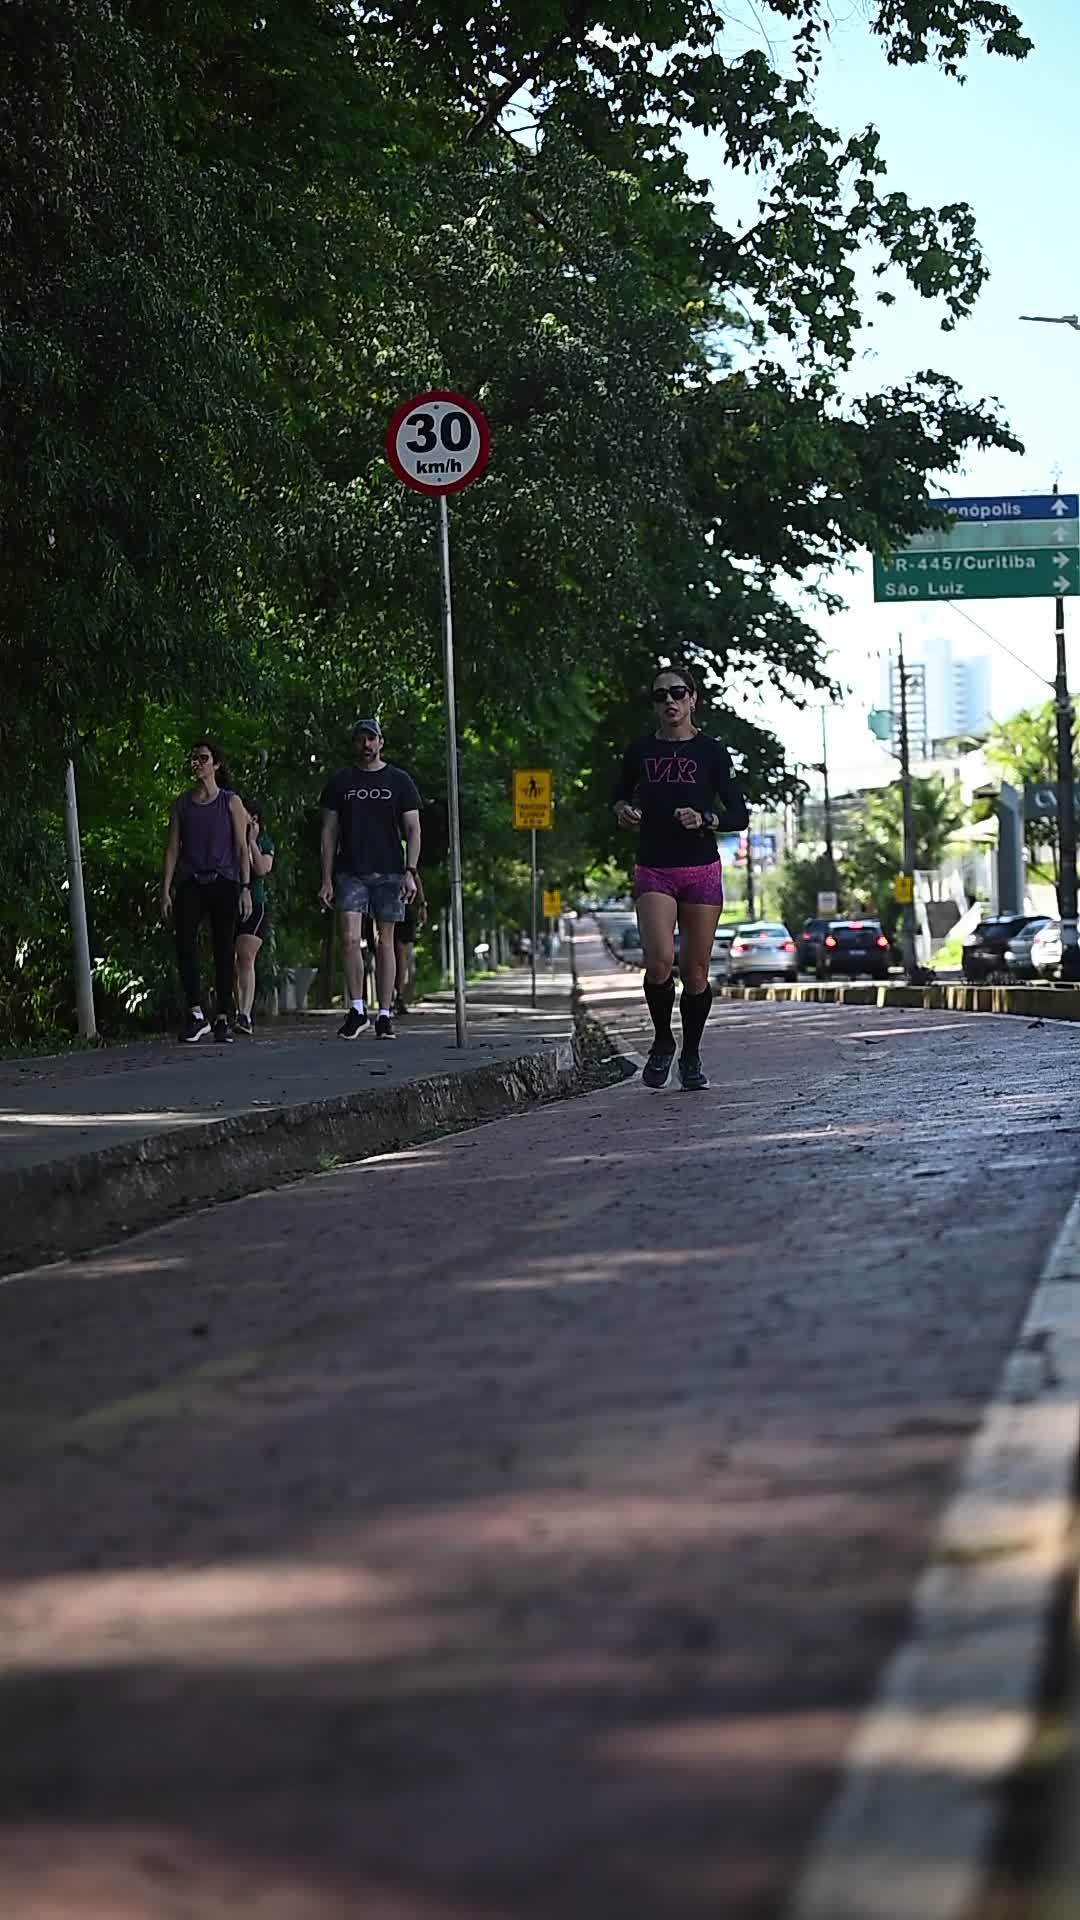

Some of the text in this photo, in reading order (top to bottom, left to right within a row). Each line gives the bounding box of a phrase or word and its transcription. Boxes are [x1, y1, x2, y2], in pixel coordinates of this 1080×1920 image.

[406, 411, 472, 453] 30
[416, 458, 462, 474] km/h
[945, 501, 1021, 518] enópolis
[927, 580, 965, 596] Luiz
